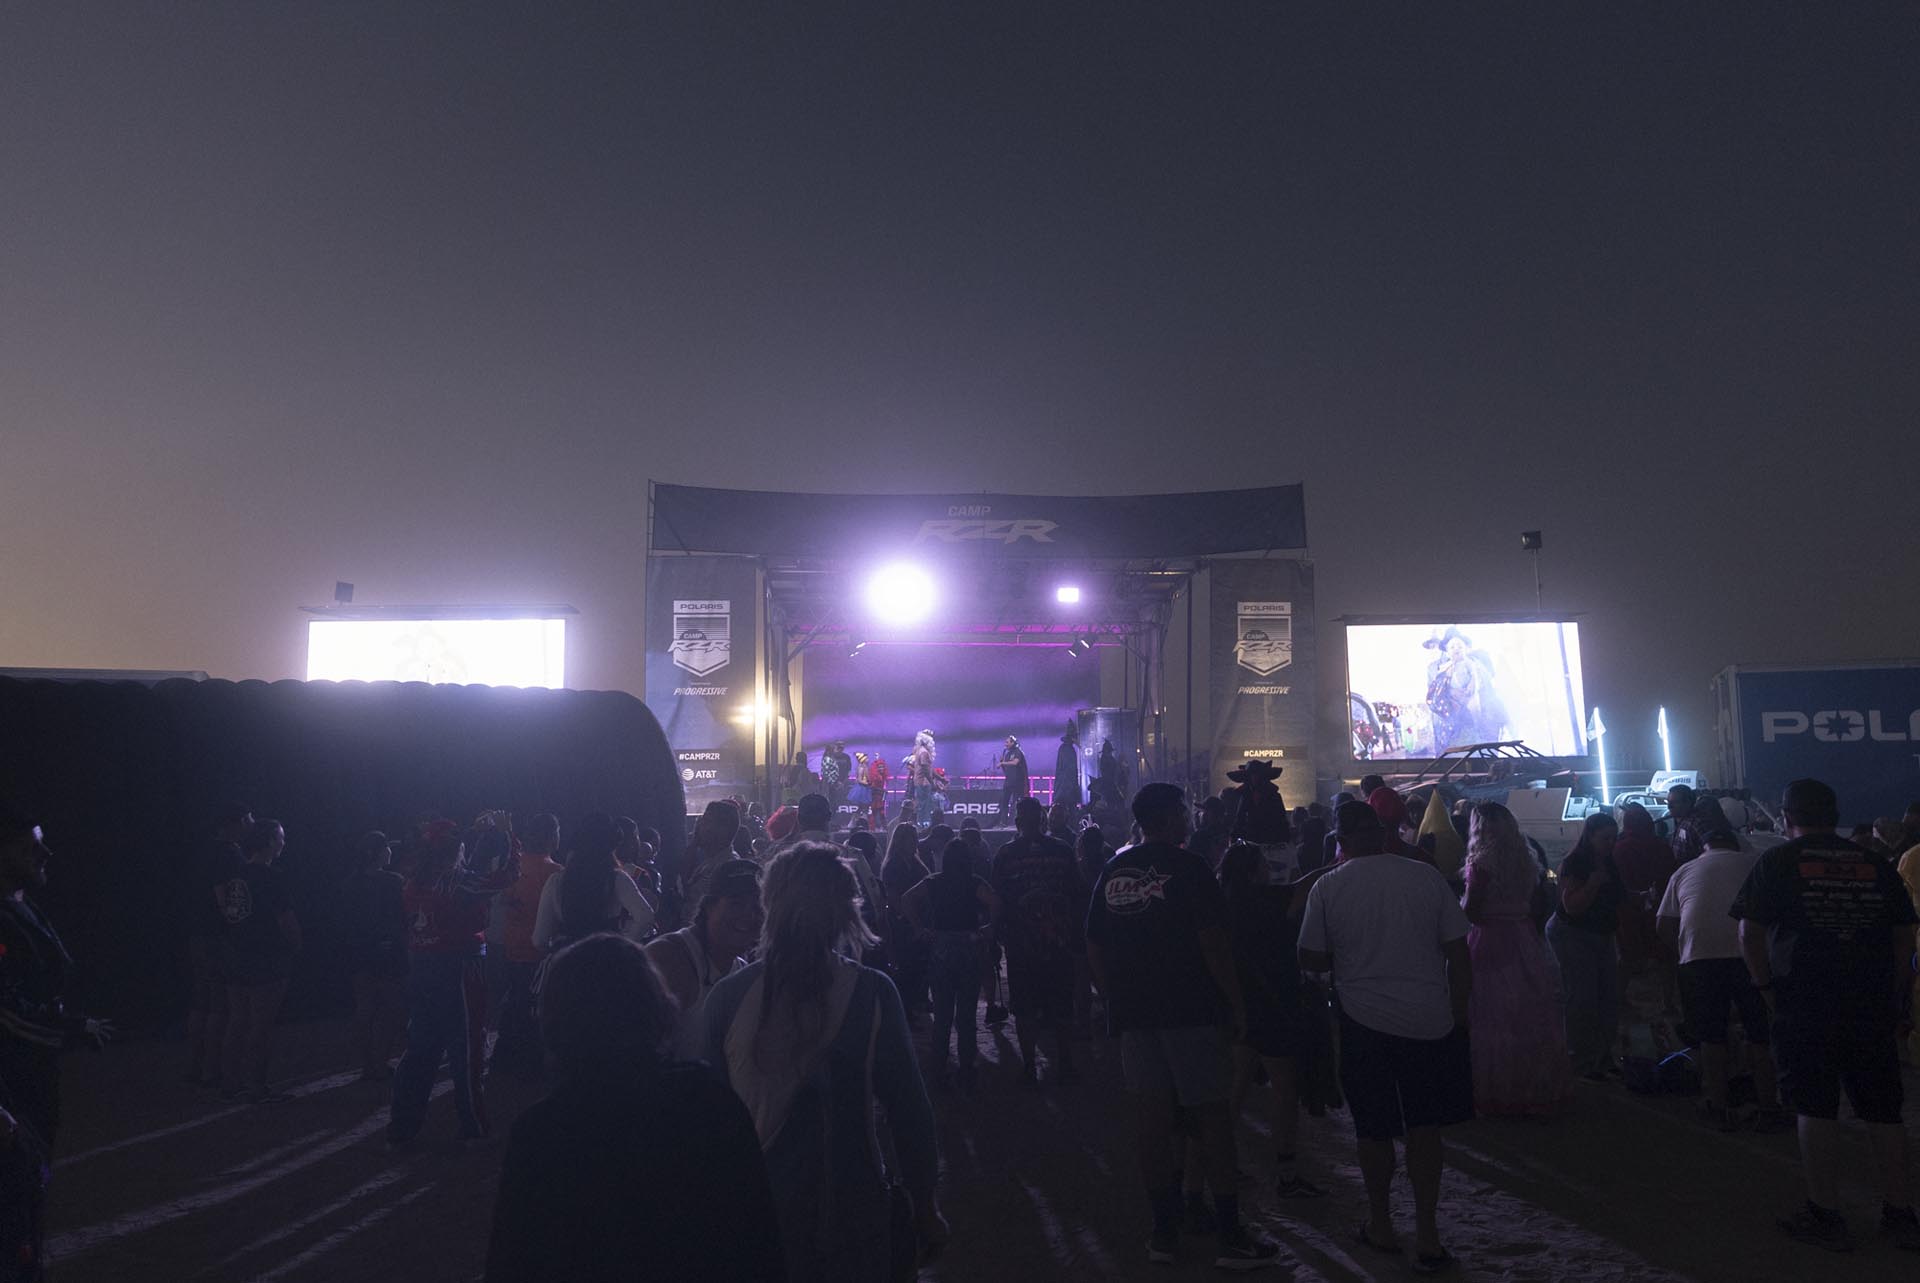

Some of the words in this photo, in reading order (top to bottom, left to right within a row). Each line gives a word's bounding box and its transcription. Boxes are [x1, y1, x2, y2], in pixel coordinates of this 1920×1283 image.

[948, 505, 991, 517] CAMP
[913, 520, 1060, 545] RZR
[683, 632, 703, 640] CAMP
[673, 687, 728, 696] PROGRESSIVE
[1237, 686, 1292, 695] PROGRESSIVE
[1761, 709, 1920, 743] POL
[679, 752, 721, 761] #CAMPRZR
[1243, 749, 1284, 758] #CAMPRZR
[695, 769, 718, 779] AT&T
